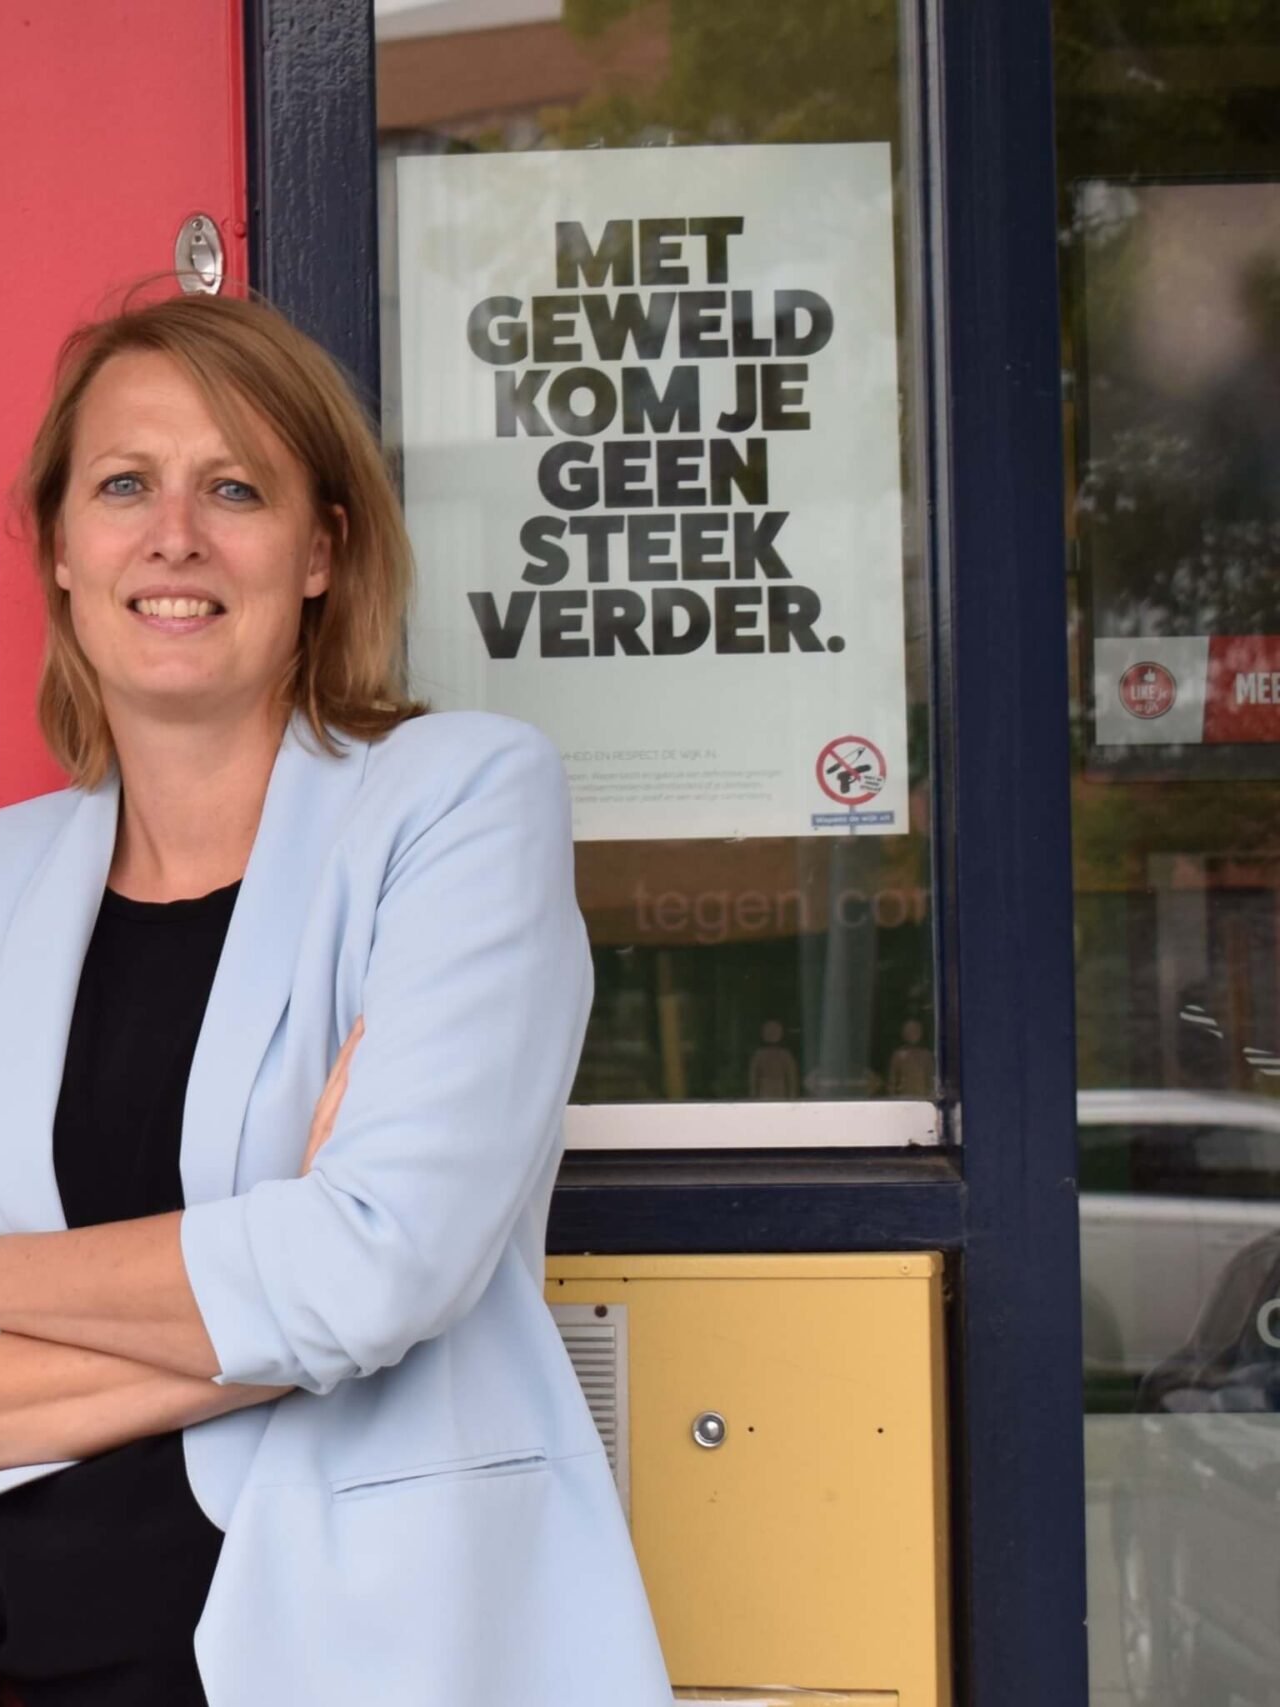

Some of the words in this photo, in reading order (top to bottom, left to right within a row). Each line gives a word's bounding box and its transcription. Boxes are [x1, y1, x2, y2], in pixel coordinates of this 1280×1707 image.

[555, 216, 745, 289] MET
[466, 289, 835, 365] GEWELD
[494, 365, 701, 438] KOM
[716, 363, 811, 433] JE
[537, 438, 769, 511] GEEN
[520, 511, 793, 586] STEEK
[467, 585, 846, 659] VERDER.
[631, 881, 809, 943] tegen
